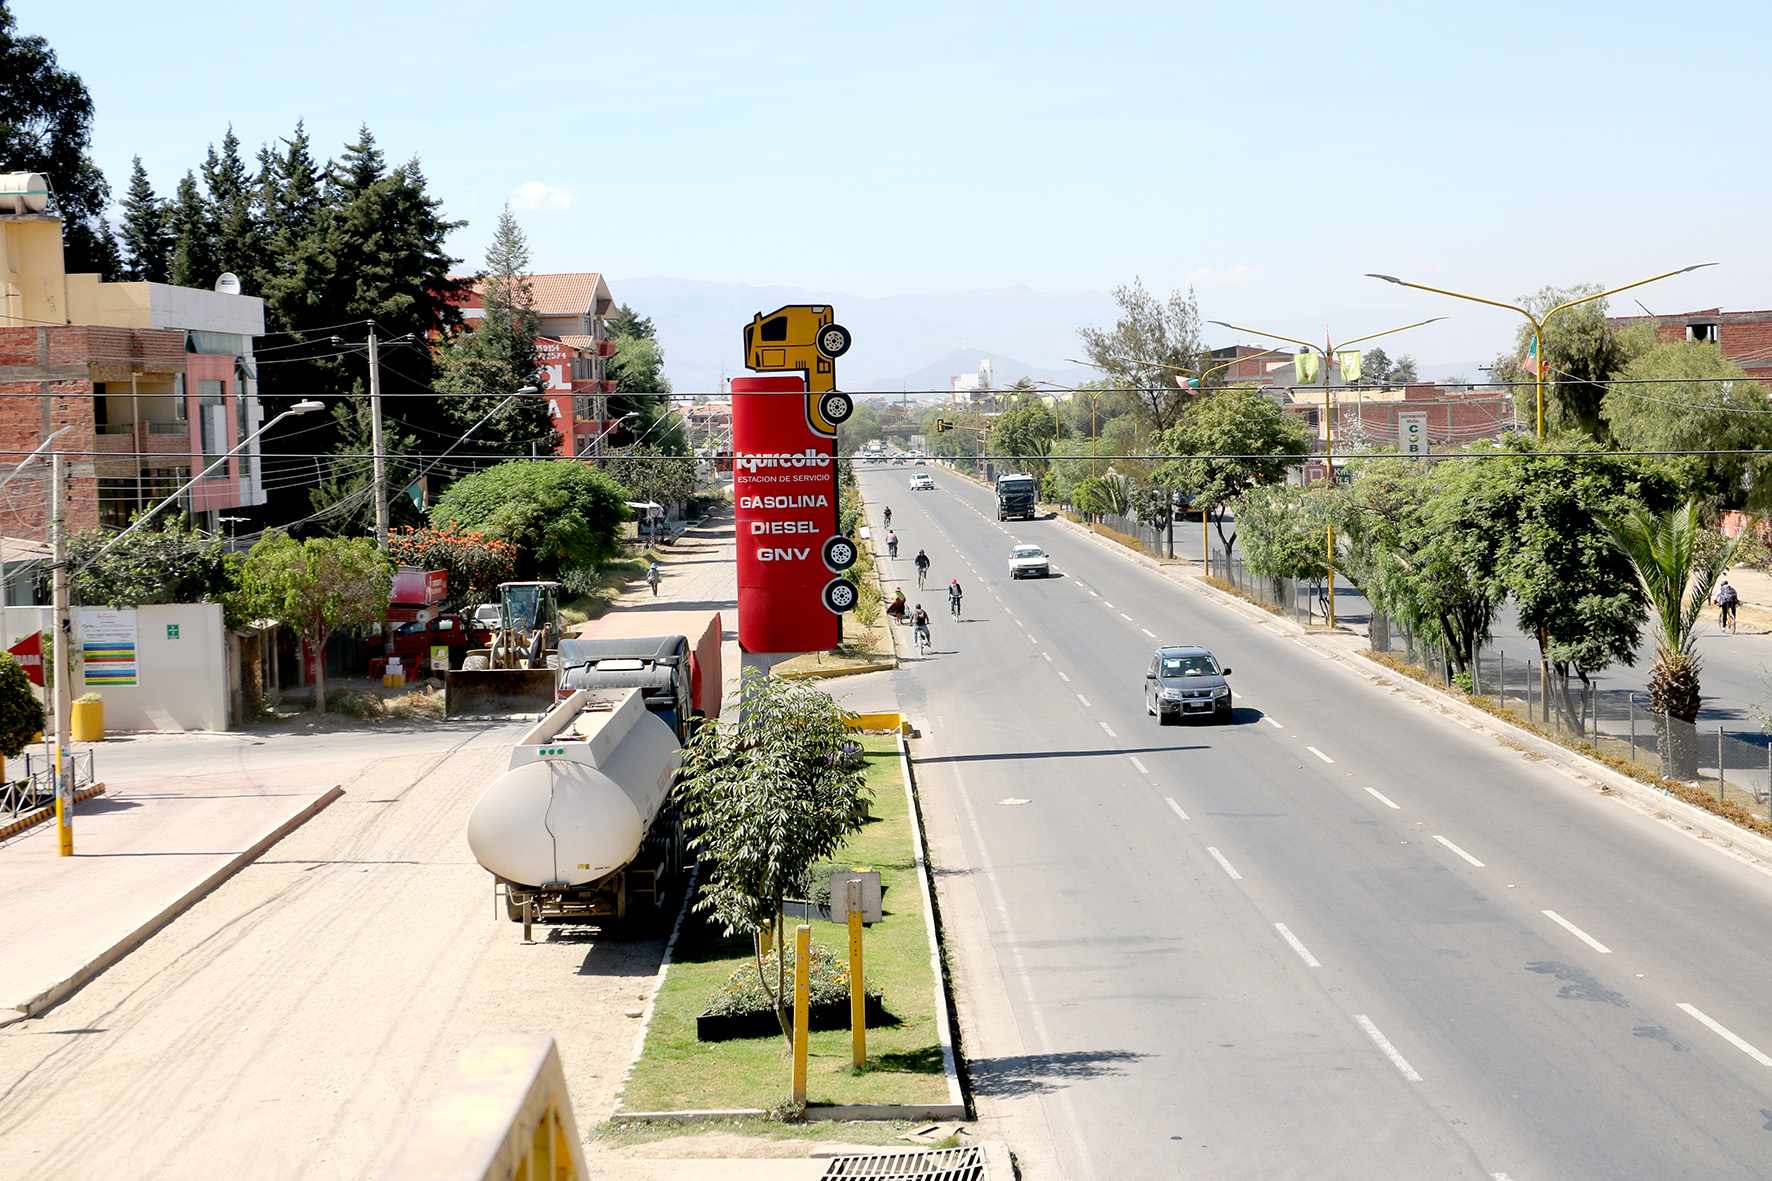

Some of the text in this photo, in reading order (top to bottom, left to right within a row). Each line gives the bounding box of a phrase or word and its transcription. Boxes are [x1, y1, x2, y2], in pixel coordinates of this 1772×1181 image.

[779, 475, 791, 483] DE
[792, 473, 830, 482] SERVICIO
[740, 494, 829, 509] GASOLINA
[751, 520, 820, 535] DIESEL
[757, 547, 811, 562] GNV
